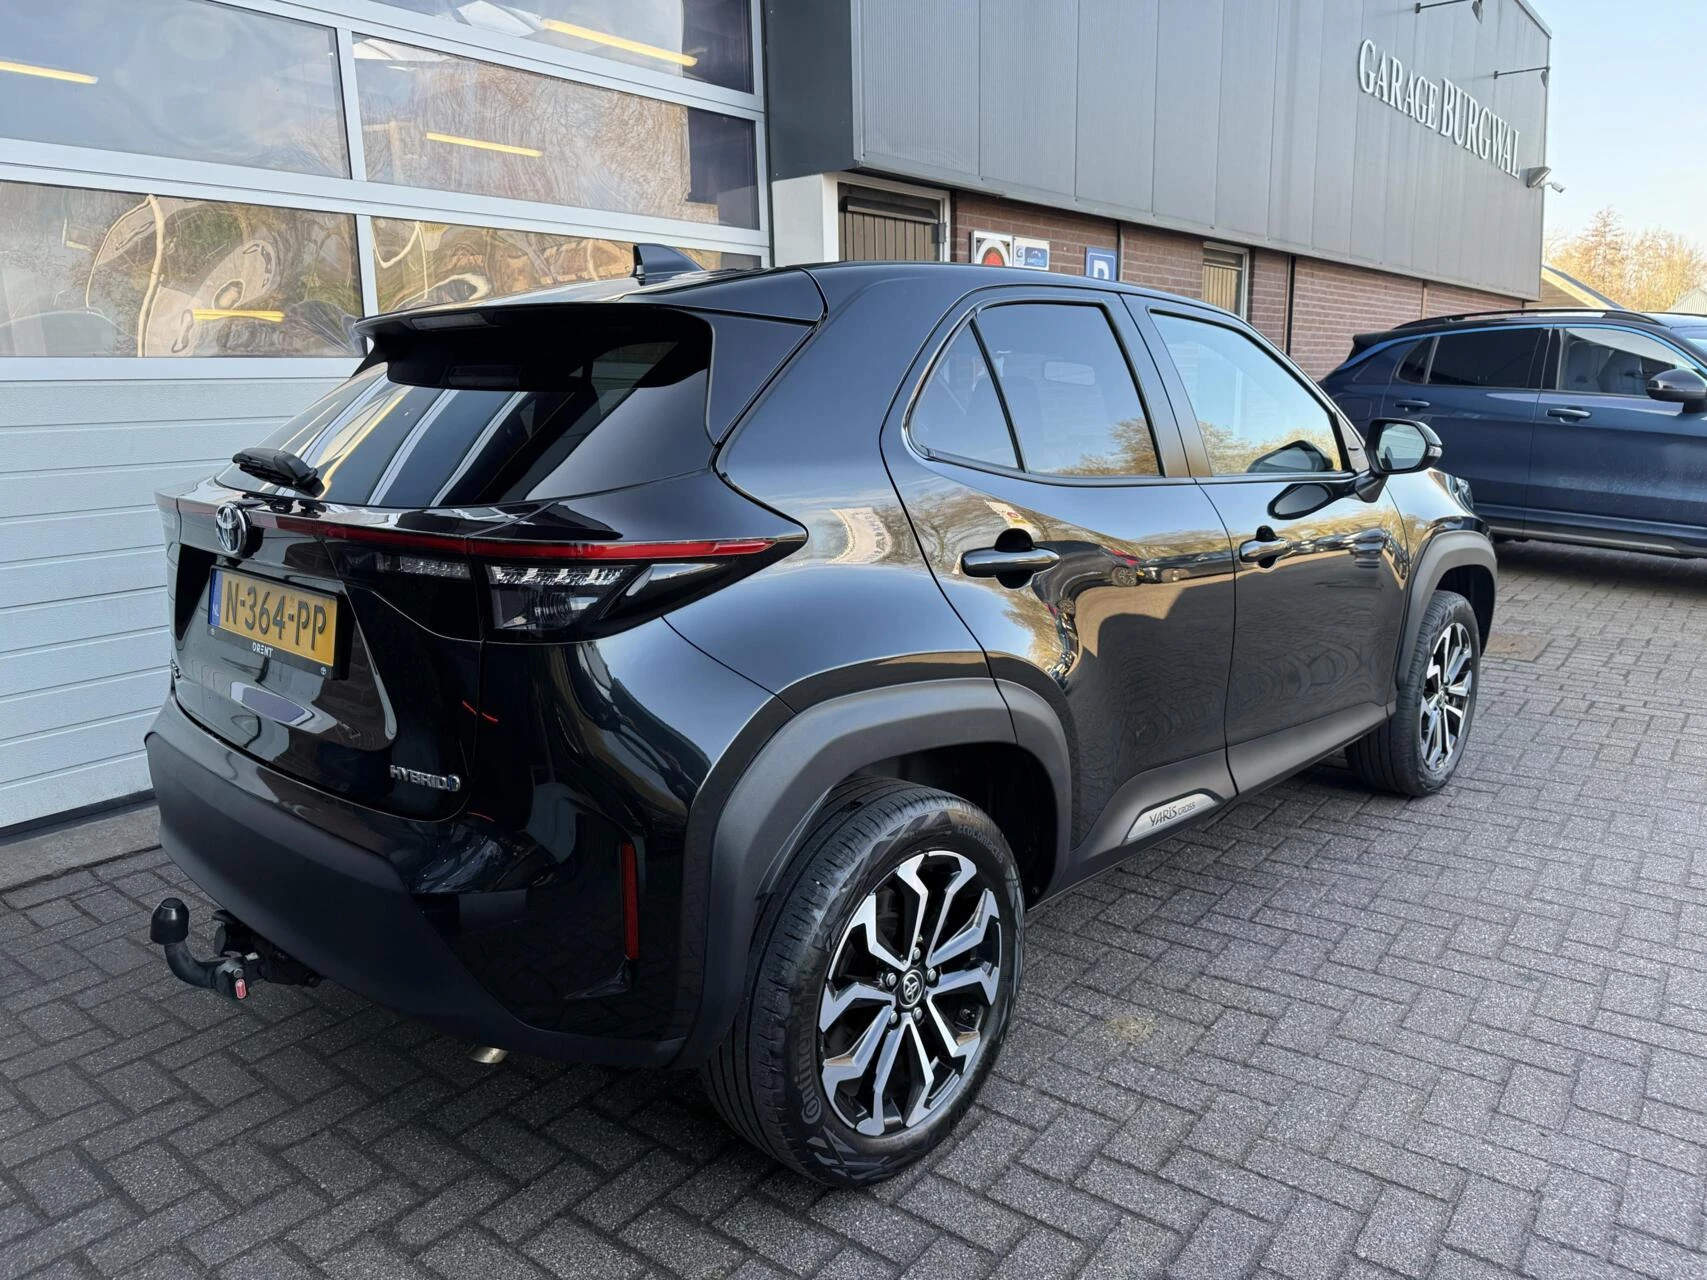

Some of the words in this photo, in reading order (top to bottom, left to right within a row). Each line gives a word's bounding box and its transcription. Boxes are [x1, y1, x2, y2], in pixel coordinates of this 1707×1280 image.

[1359, 39, 1438, 130] GARAGE
[1440, 78, 1521, 179] BURGWAL
[225, 580, 327, 651] N-364-PP
[252, 641, 273, 658] ORENT
[390, 764, 447, 790] HYBRID
